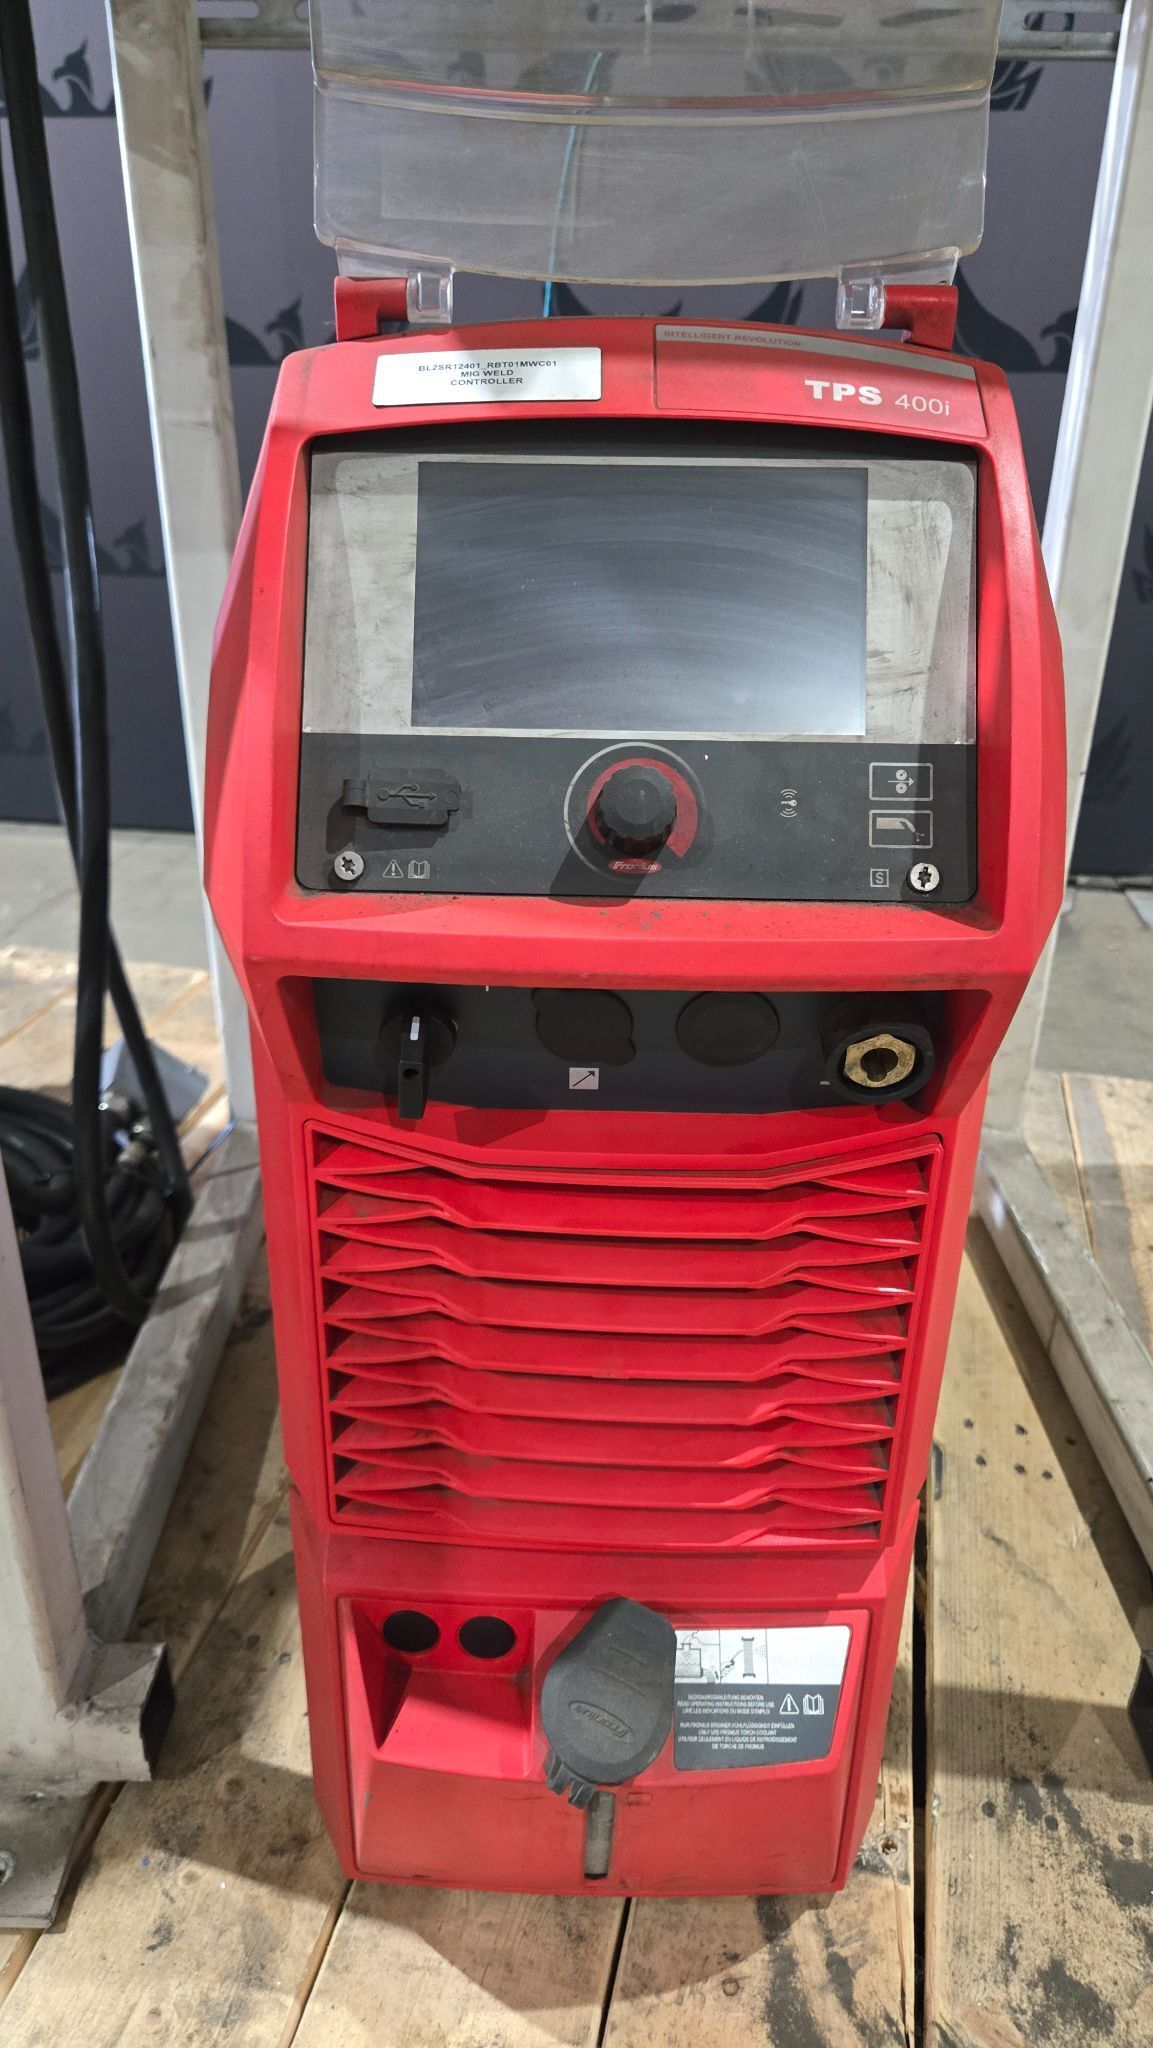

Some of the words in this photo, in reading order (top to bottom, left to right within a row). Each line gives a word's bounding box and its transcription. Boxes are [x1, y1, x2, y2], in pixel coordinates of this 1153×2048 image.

[664, 331, 731, 340] INTELLIGENT
[734, 335, 802, 346] REVOLUTION
[460, 370, 480, 378] MIG
[482, 369, 514, 377] WELD
[450, 377, 524, 386] CONTROLLER
[804, 379, 883, 405] TPS
[894, 394, 950, 416] 400i
